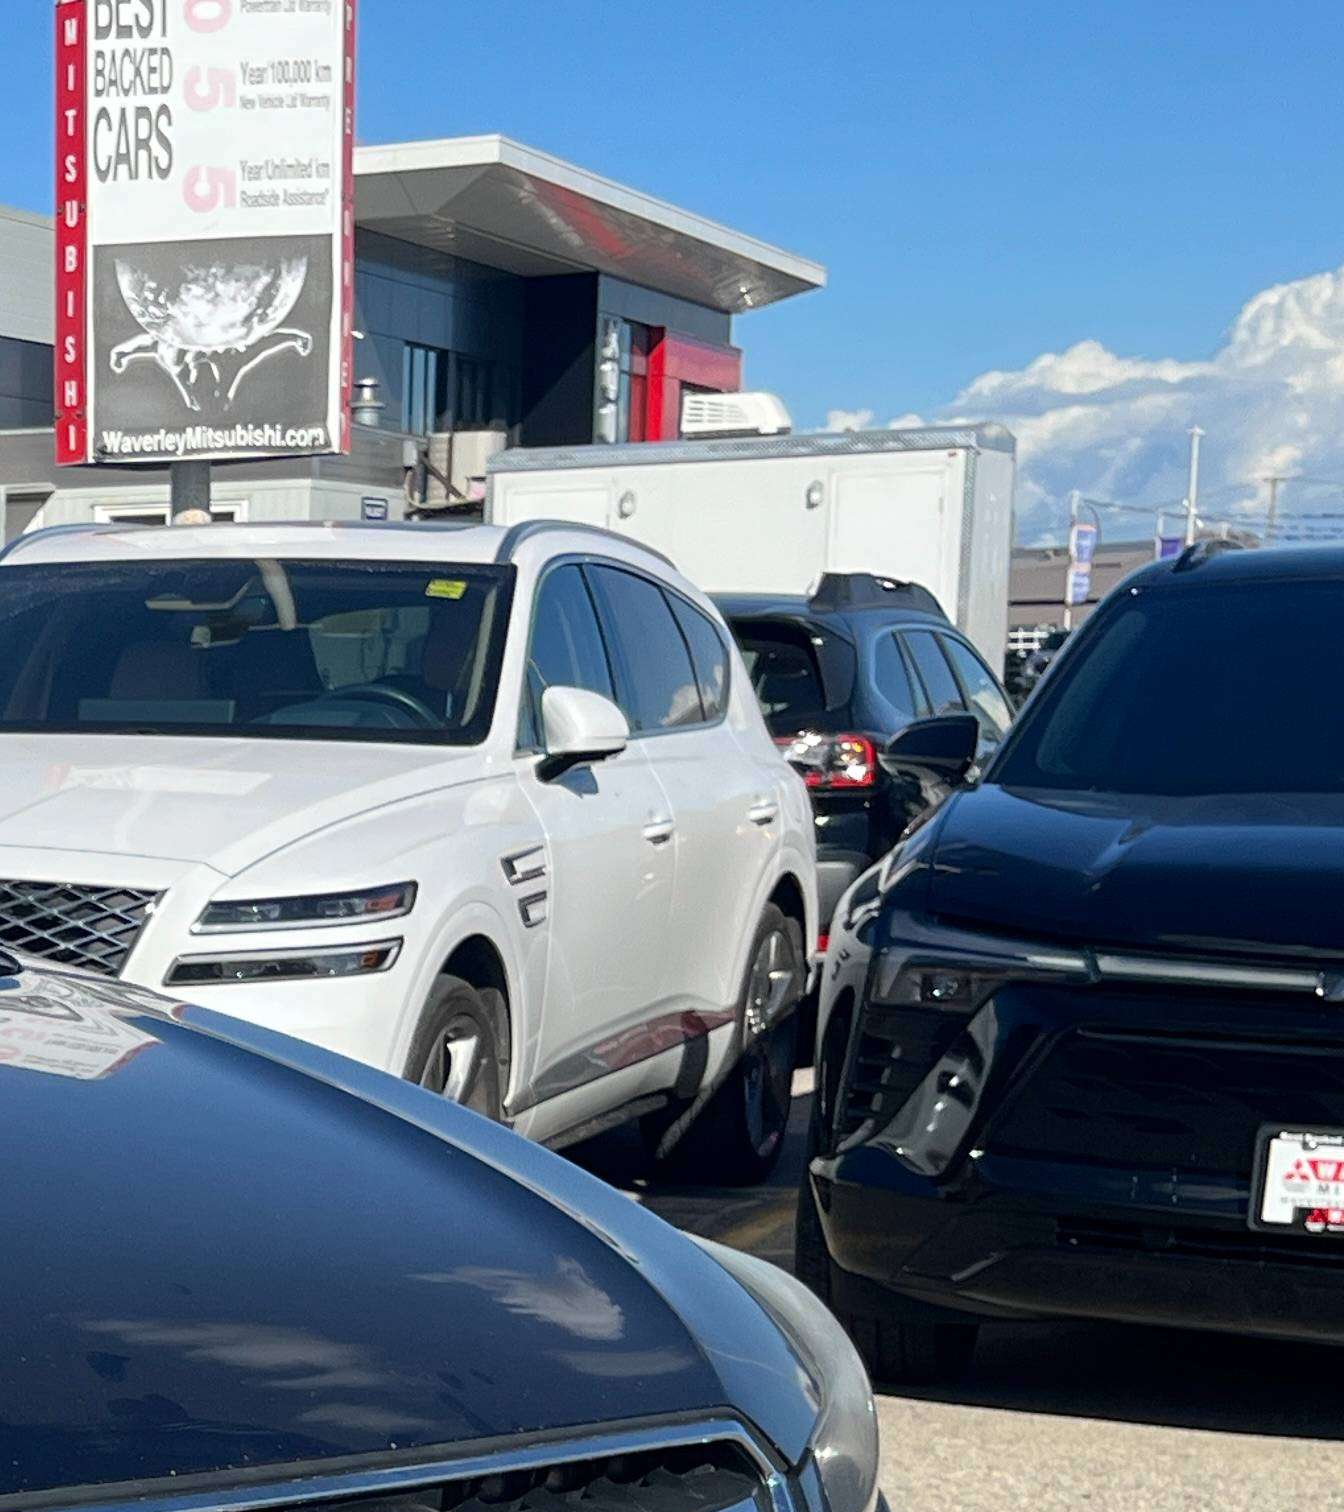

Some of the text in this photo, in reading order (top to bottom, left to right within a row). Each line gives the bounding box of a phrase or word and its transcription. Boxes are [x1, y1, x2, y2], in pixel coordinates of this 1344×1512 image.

[94, 0, 168, 40] BEST
[94, 47, 173, 98] BACKED
[240, 61, 268, 86] Year
[93, 104, 173, 183] CARS
[239, 160, 263, 182] Year
[63, 17, 79, 451] MITSUBISHI
[102, 424, 325, 455] WaverleyMitsubishi.com
